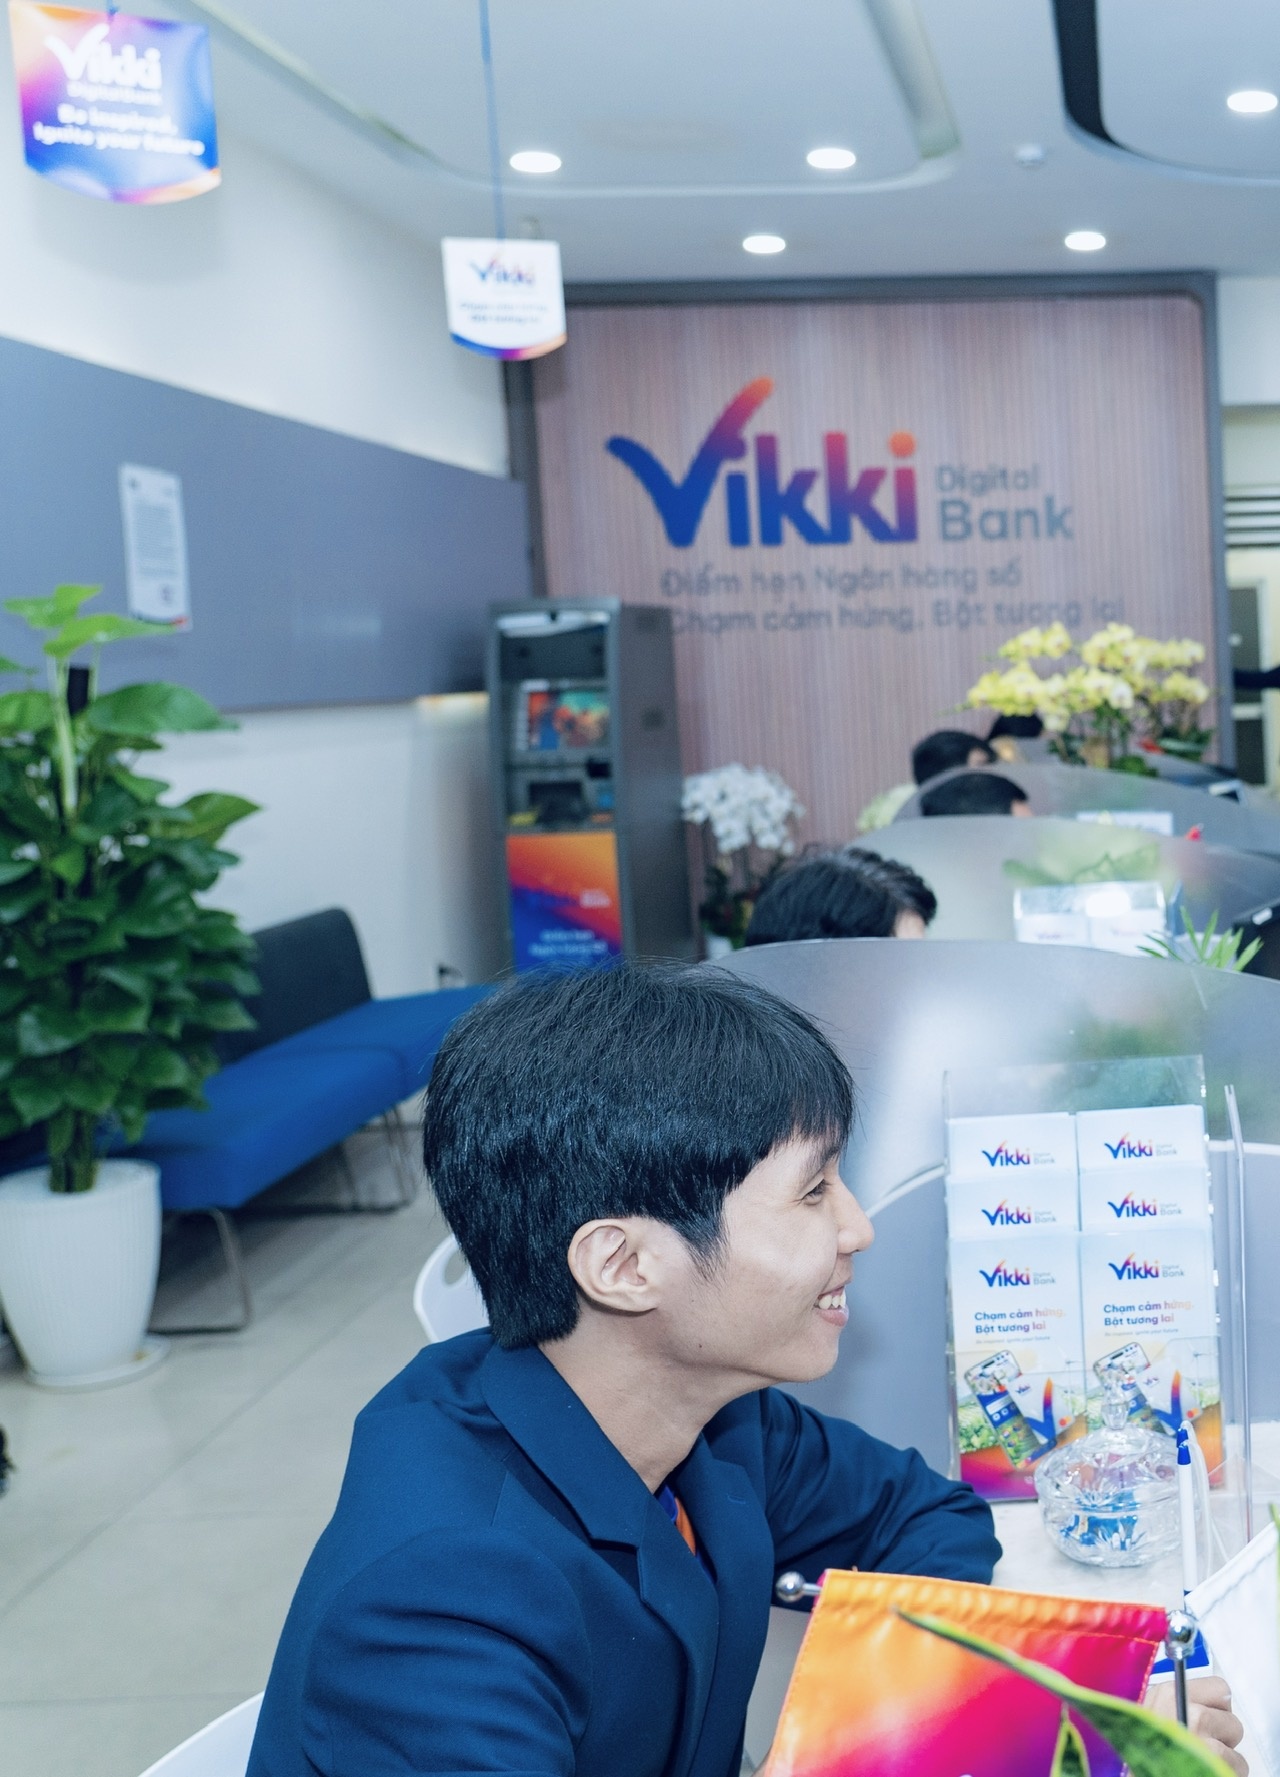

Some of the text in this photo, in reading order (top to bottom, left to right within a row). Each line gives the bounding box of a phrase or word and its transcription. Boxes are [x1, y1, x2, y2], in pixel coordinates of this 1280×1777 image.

[605, 376, 918, 549] Vikki
[936, 462, 1039, 496] Digital
[940, 493, 1074, 542] Bank
[982, 1140, 1031, 1167] Vikki
[1104, 1131, 1153, 1159] Vikki
[981, 1199, 1031, 1226] Vikki
[1107, 1191, 1157, 1218] Vikki
[979, 1259, 1030, 1287] Vikki
[1108, 1252, 1159, 1280] Vikki
[1162, 1269, 1185, 1279] Bank
[1033, 1276, 1056, 1285] Bank
[974, 1311, 1007, 1322] Chạm
[1009, 1308, 1033, 1319] cảm
[1103, 1303, 1136, 1315] Chạm
[1138, 1301, 1162, 1311] cảm
[1104, 1313, 1174, 1328] Bật tương lai
[975, 1320, 1046, 1335] Bật tương lai
